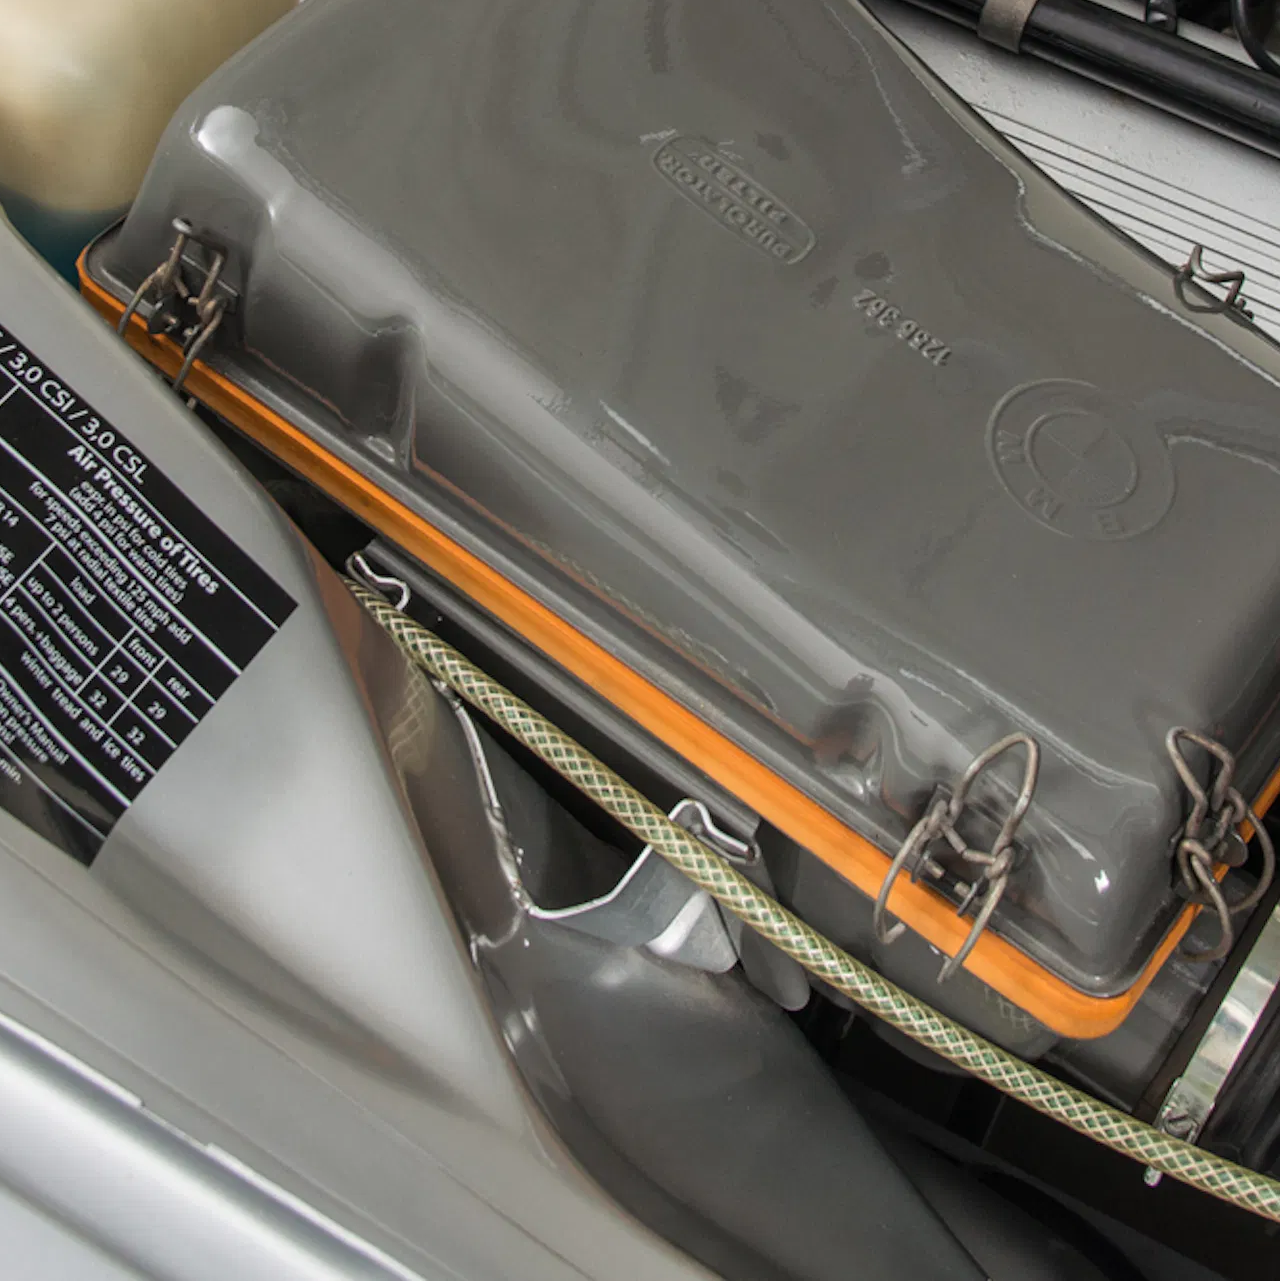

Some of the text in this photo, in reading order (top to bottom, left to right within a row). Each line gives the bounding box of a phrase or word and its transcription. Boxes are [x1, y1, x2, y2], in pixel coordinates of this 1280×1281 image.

[661, 152, 792, 260] PUROLATOR
[8, 352, 42, 383] 3,0
[40, 380, 75, 412] CSI
[67, 410, 88, 420] /
[81, 417, 114, 448] 3,0
[112, 445, 146, 484] CSL
[2, 510, 18, 527] 14
[44, 512, 57, 523] 7
[50, 522, 72, 540] psi
[67, 445, 218, 594] Air Pressure of Tires
[29, 481, 192, 644] for speeds exceeding 125 mph add
[77, 549, 108, 580] radial
[92, 510, 103, 520] 4
[113, 532, 131, 550] for
[128, 549, 157, 579] warm
[155, 575, 183, 604] tires)
[128, 528, 145, 546] for
[142, 545, 168, 569] cold
[164, 565, 187, 589] tires
[5, 597, 16, 608] 4
[70, 576, 96, 605] load
[103, 577, 135, 611] textile
[27, 577, 98, 656] up to 2 persons
[133, 607, 157, 632] tires
[128, 638, 156, 667] front
[110, 665, 128, 683] 29
[166, 677, 190, 698] rear
[89, 690, 107, 709] 32
[147, 701, 166, 719] 29
[21, 651, 145, 782] winter tread and ice tires
[5, 716, 48, 762] pressure
[29, 721, 69, 764] Manual
[126, 727, 144, 745] 32
